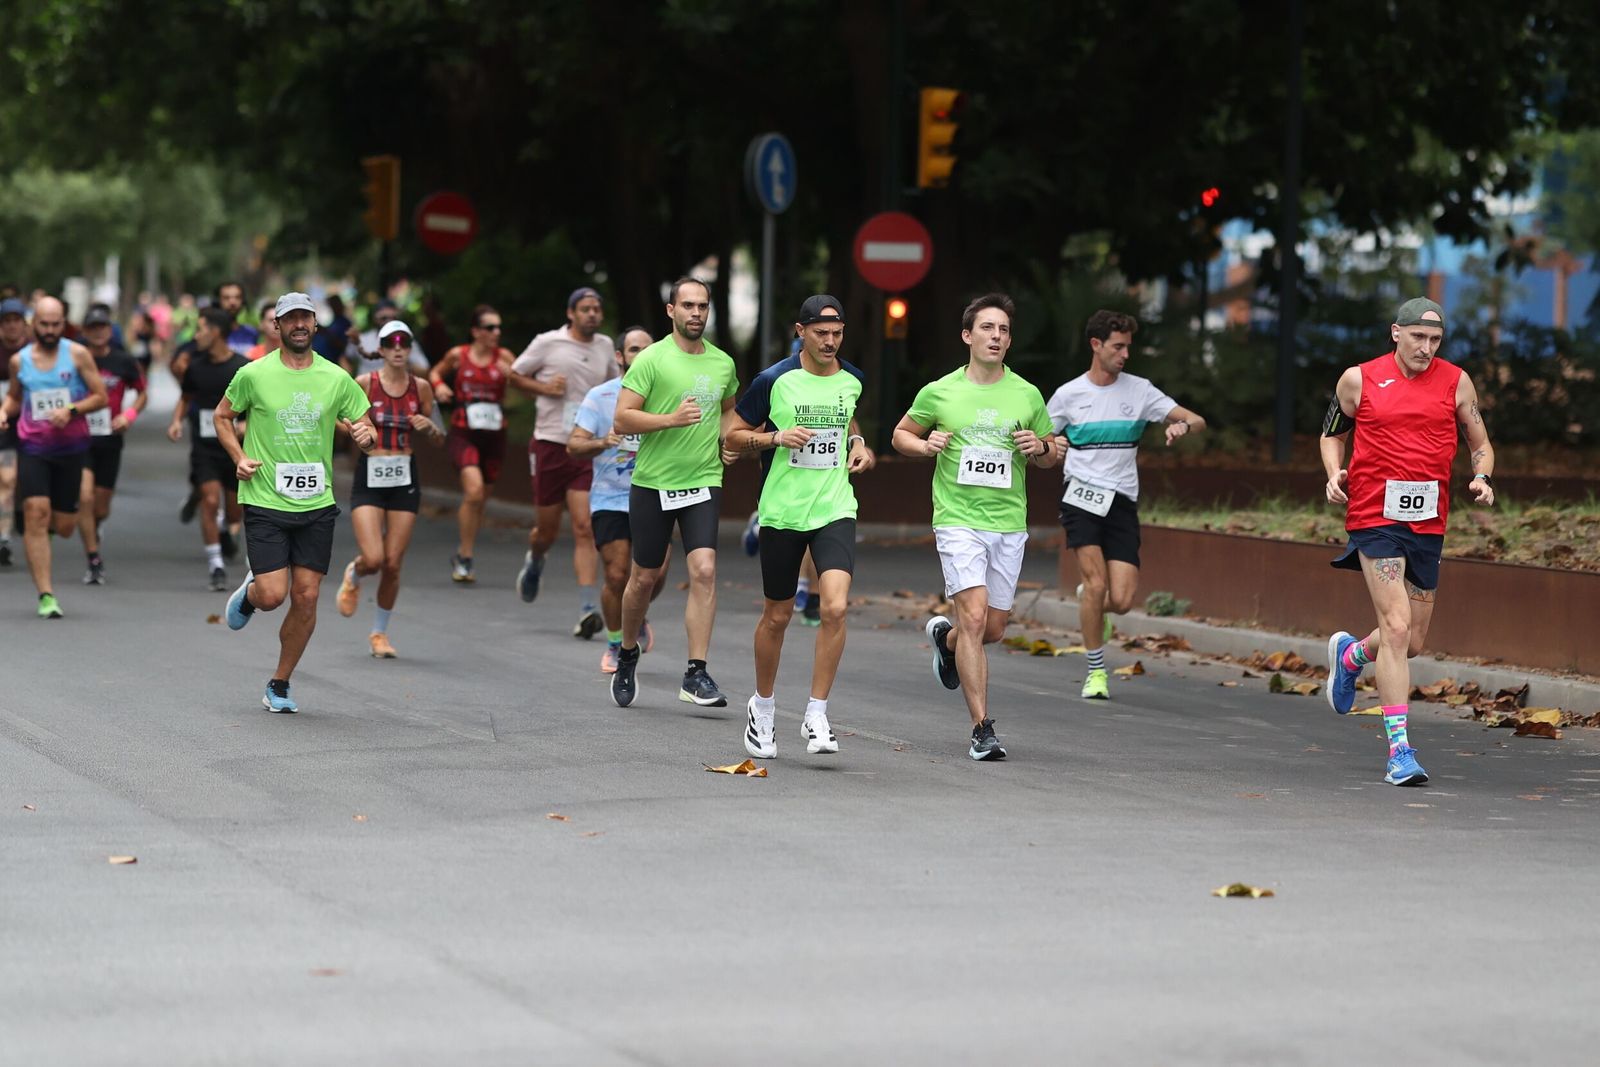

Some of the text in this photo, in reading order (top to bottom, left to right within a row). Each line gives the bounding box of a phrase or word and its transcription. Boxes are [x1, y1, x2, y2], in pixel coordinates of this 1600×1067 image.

[794, 405, 810, 414] VIII
[374, 465, 404, 478] 526
[965, 460, 1006, 475] 1201
[283, 475, 318, 488] 765
[1073, 486, 1105, 505] 483
[1399, 495, 1425, 509] 90
